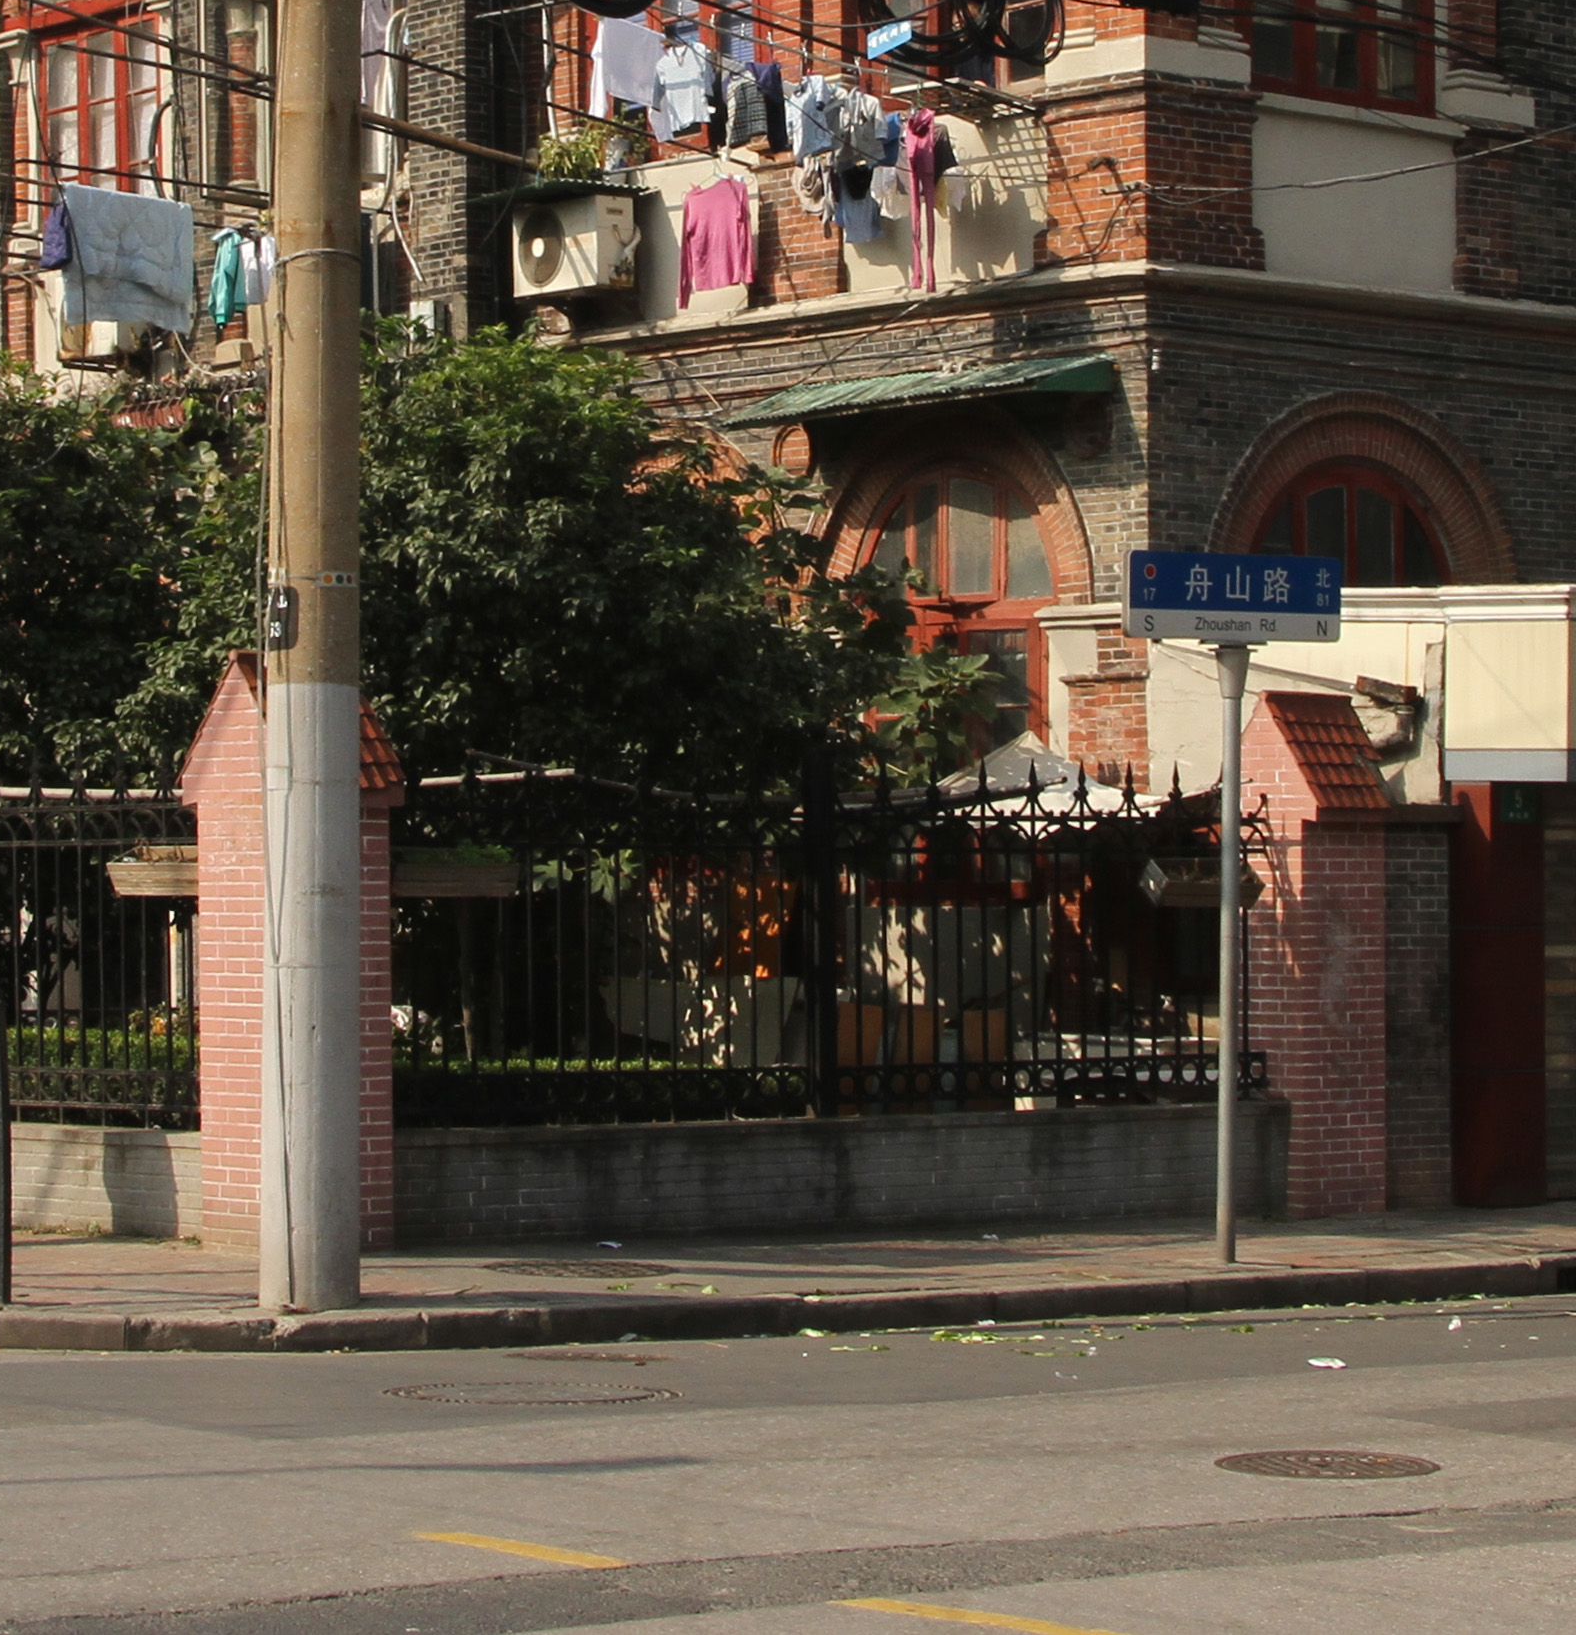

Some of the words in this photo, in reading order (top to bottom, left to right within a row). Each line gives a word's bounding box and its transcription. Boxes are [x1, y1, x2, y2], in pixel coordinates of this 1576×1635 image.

[1184, 563, 1291, 604] 舟山路
[1315, 568, 1331, 588] 北
[1143, 587, 1157, 601] 17
[1316, 593, 1330, 607] 81
[1143, 615, 1155, 632] S
[1194, 616, 1252, 632] Zhoushan
[1316, 620, 1328, 637] N
